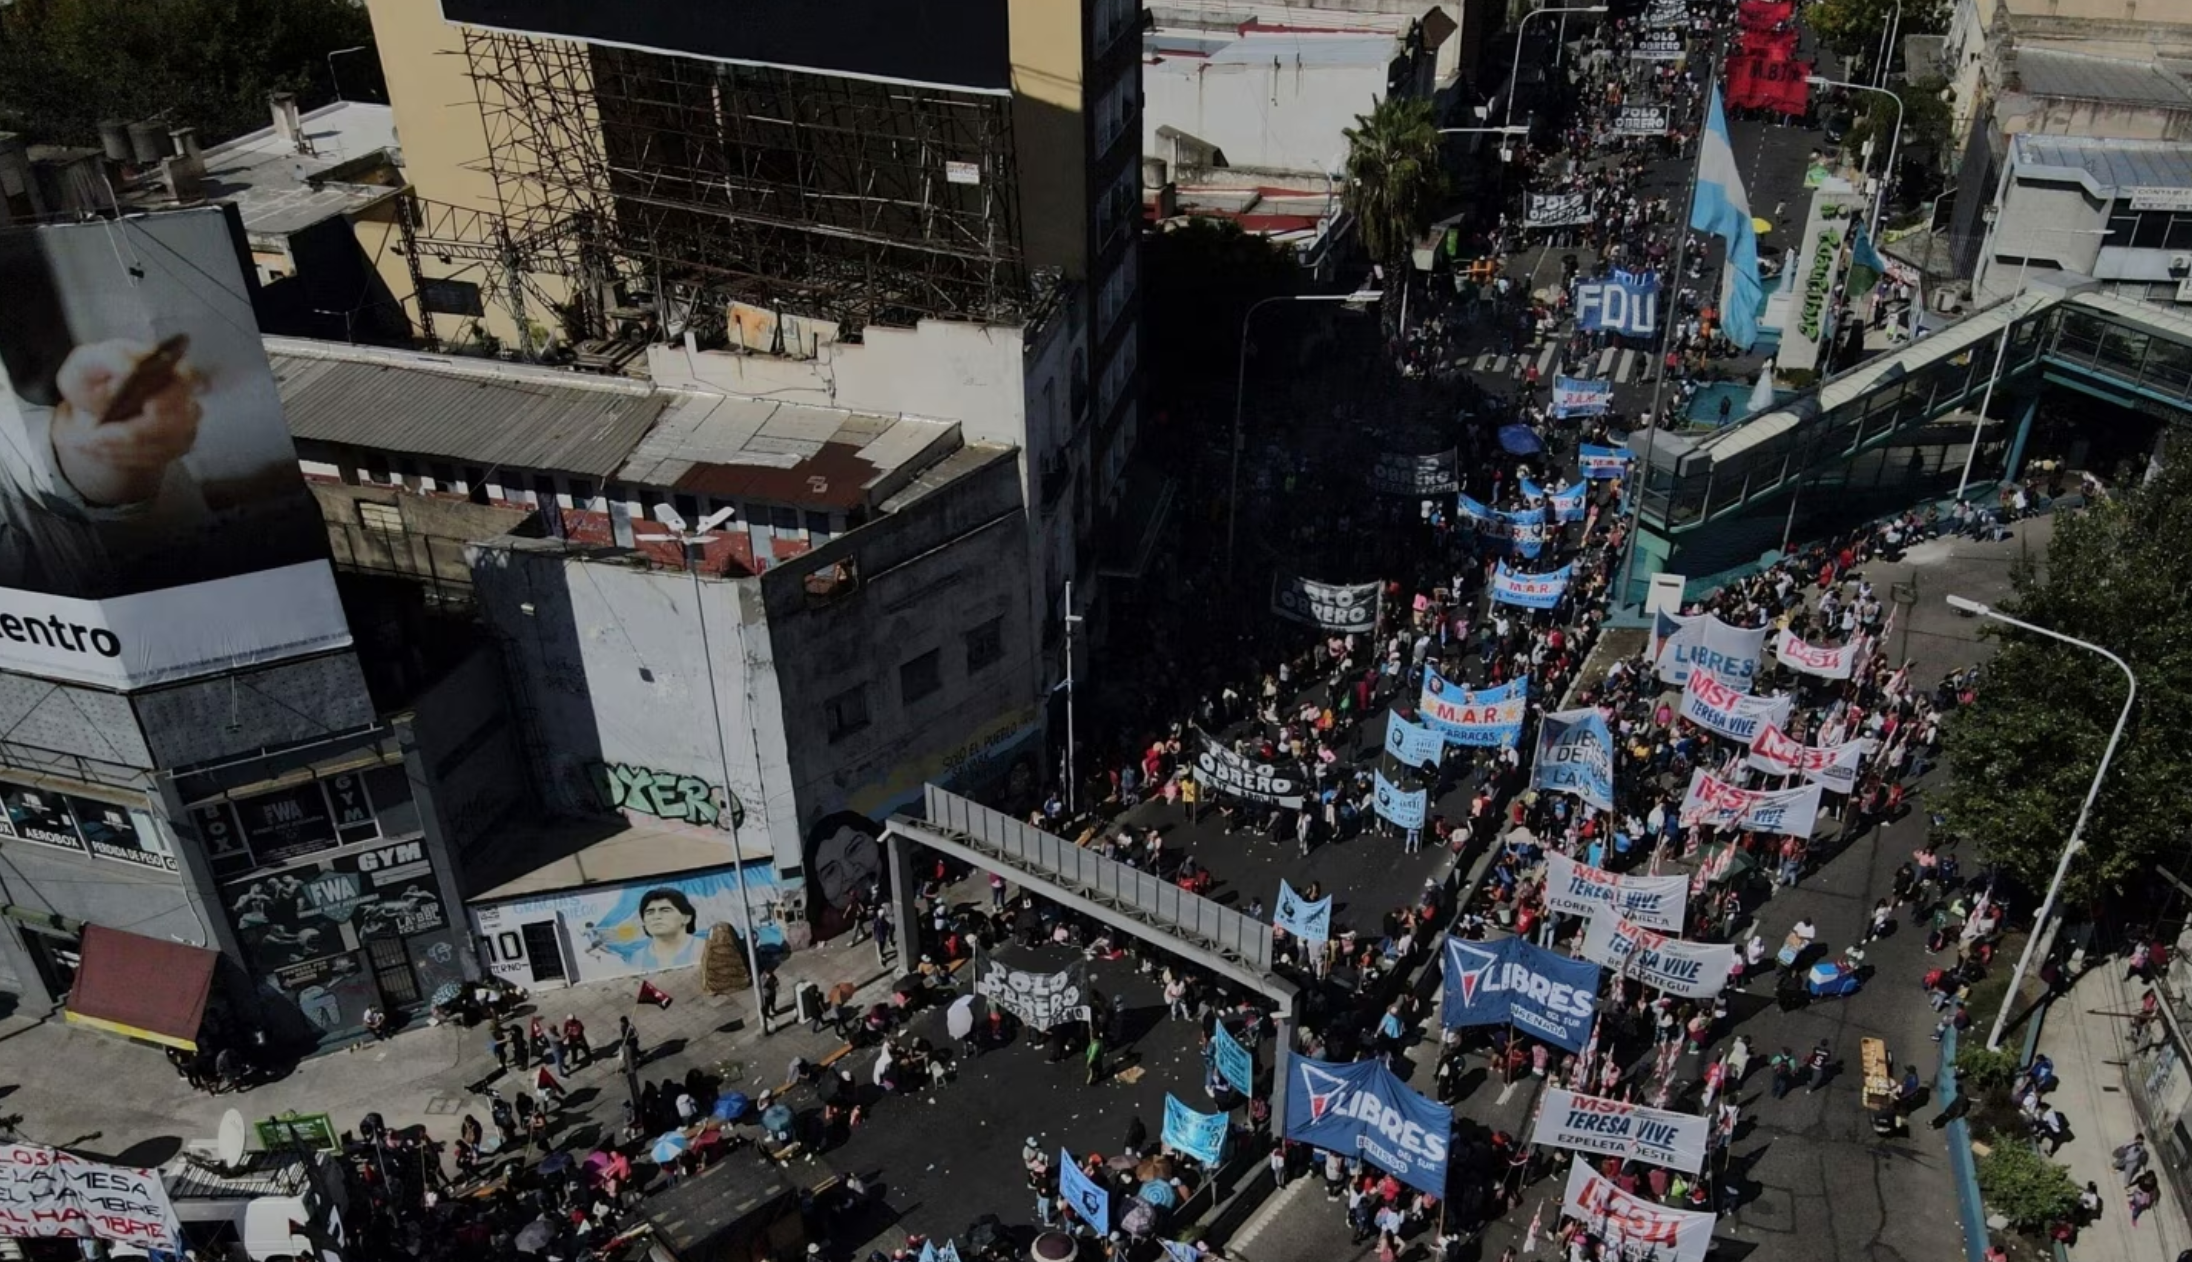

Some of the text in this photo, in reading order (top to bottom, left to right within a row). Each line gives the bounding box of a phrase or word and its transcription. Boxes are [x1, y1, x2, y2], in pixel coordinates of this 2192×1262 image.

[1621, 107, 1660, 118] POLO
[1532, 194, 1584, 210] POLO
[1576, 284, 1655, 333] FDU
[0, 613, 121, 657] entro
[1675, 644, 1755, 678] LIBRES
[1687, 667, 1745, 712] MST
[1691, 699, 1727, 729] TERESA
[1729, 715, 1758, 735] VIVE
[1199, 752, 1293, 794] OBRERO
[25, 827, 80, 848] AEROBOX
[357, 841, 422, 872] GYM
[310, 876, 361, 907] FWA
[1626, 891, 1663, 910] VIVE
[481, 931, 523, 963] 10
[1616, 919, 1667, 949] MST
[1663, 957, 1703, 979] VIVE
[1481, 962, 1595, 1018] LIBRES
[1511, 1004, 1567, 1040] NSENADA
[1570, 1095, 1634, 1115] MST
[1331, 1090, 1447, 1162] LIBRES
[1557, 1132, 1626, 1152] EZPELETA
[1565, 1110, 1679, 1146] TERESA VIVE
[60, 1168, 151, 1201] MESA
